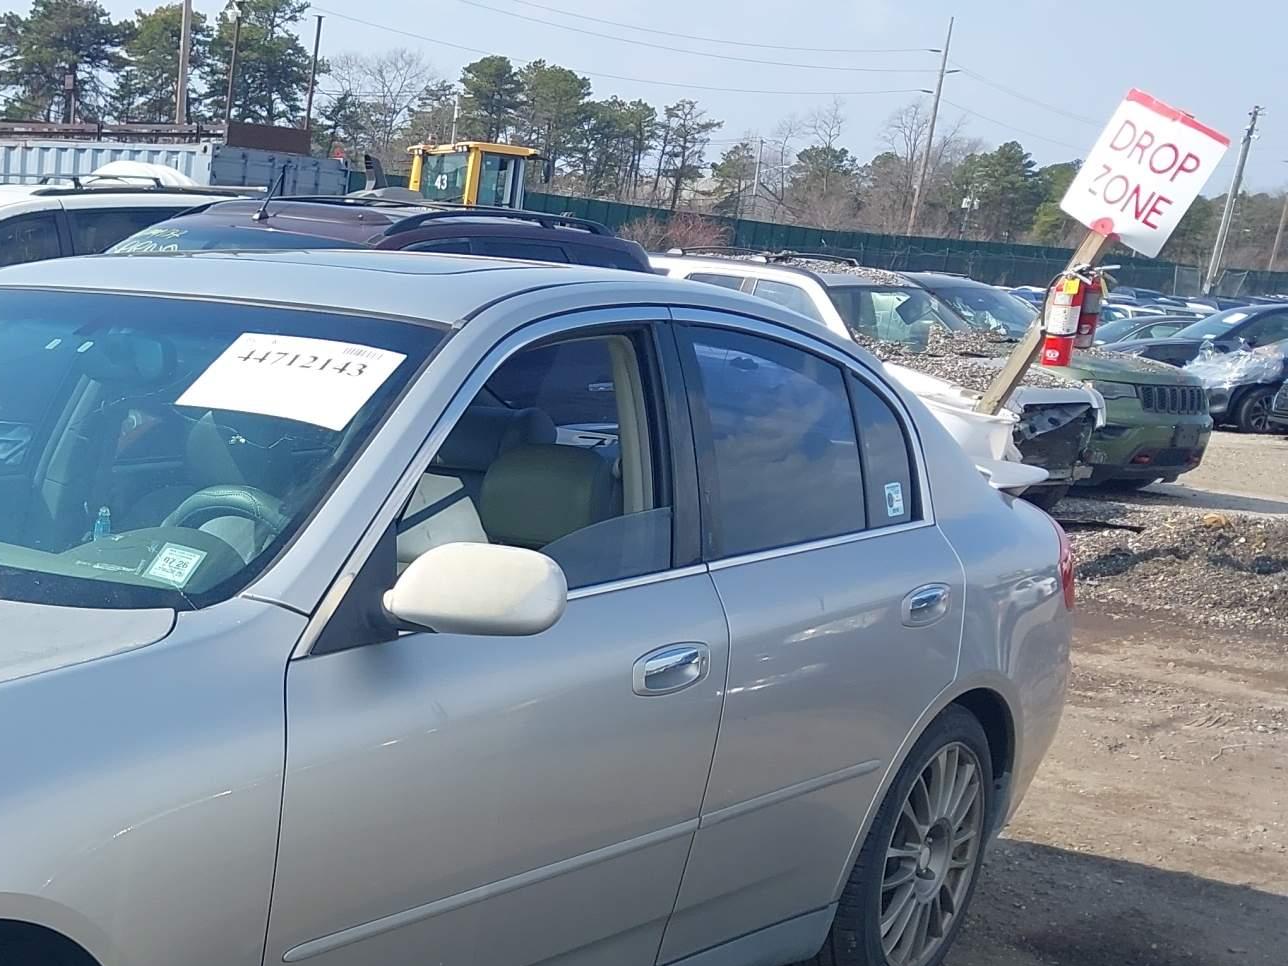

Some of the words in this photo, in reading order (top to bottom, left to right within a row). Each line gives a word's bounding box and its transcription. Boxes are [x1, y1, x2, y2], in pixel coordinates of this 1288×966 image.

[1109, 119, 1201, 183] DROP
[434, 173, 448, 190] 43
[1087, 163, 1174, 230] ZONE
[236, 349, 368, 378] 44712143
